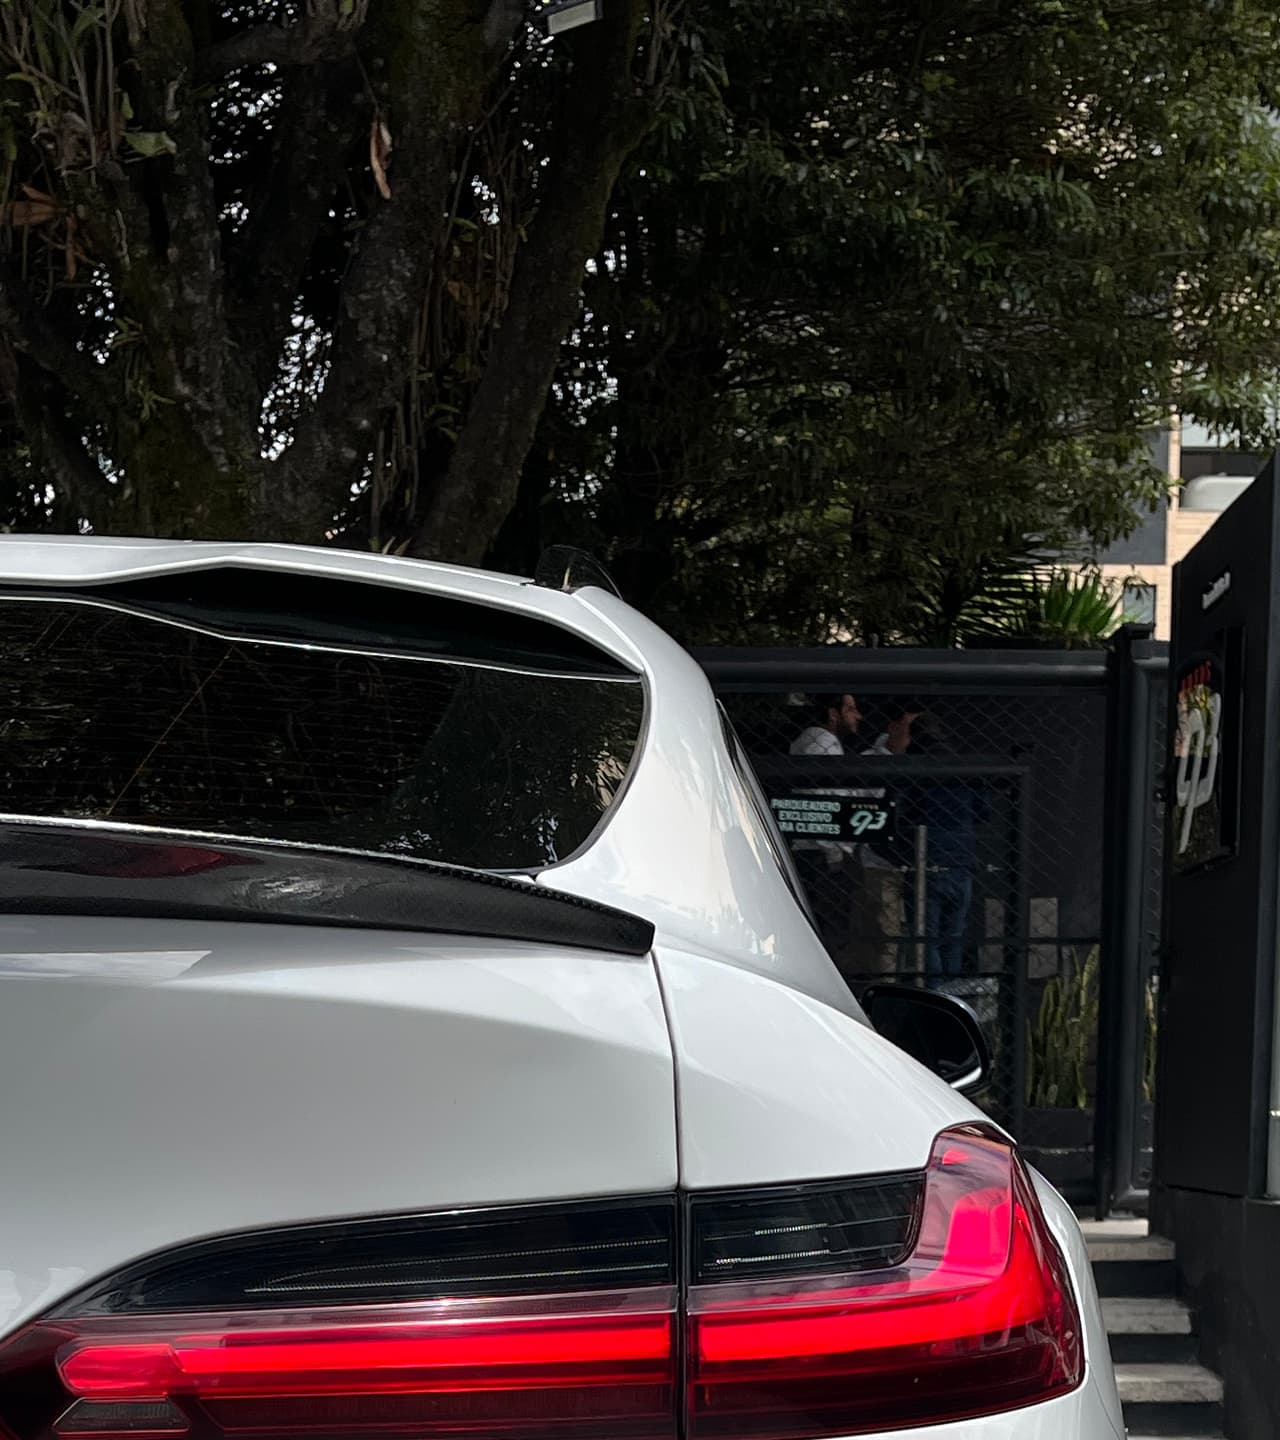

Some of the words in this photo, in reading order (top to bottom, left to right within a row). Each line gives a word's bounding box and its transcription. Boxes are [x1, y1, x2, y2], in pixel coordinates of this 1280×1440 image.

[1176, 692, 1222, 854] 93
[778, 810, 832, 822] EXCLUSIVO
[849, 810, 888, 836] 93
[795, 823, 841, 835] CLIENTES
